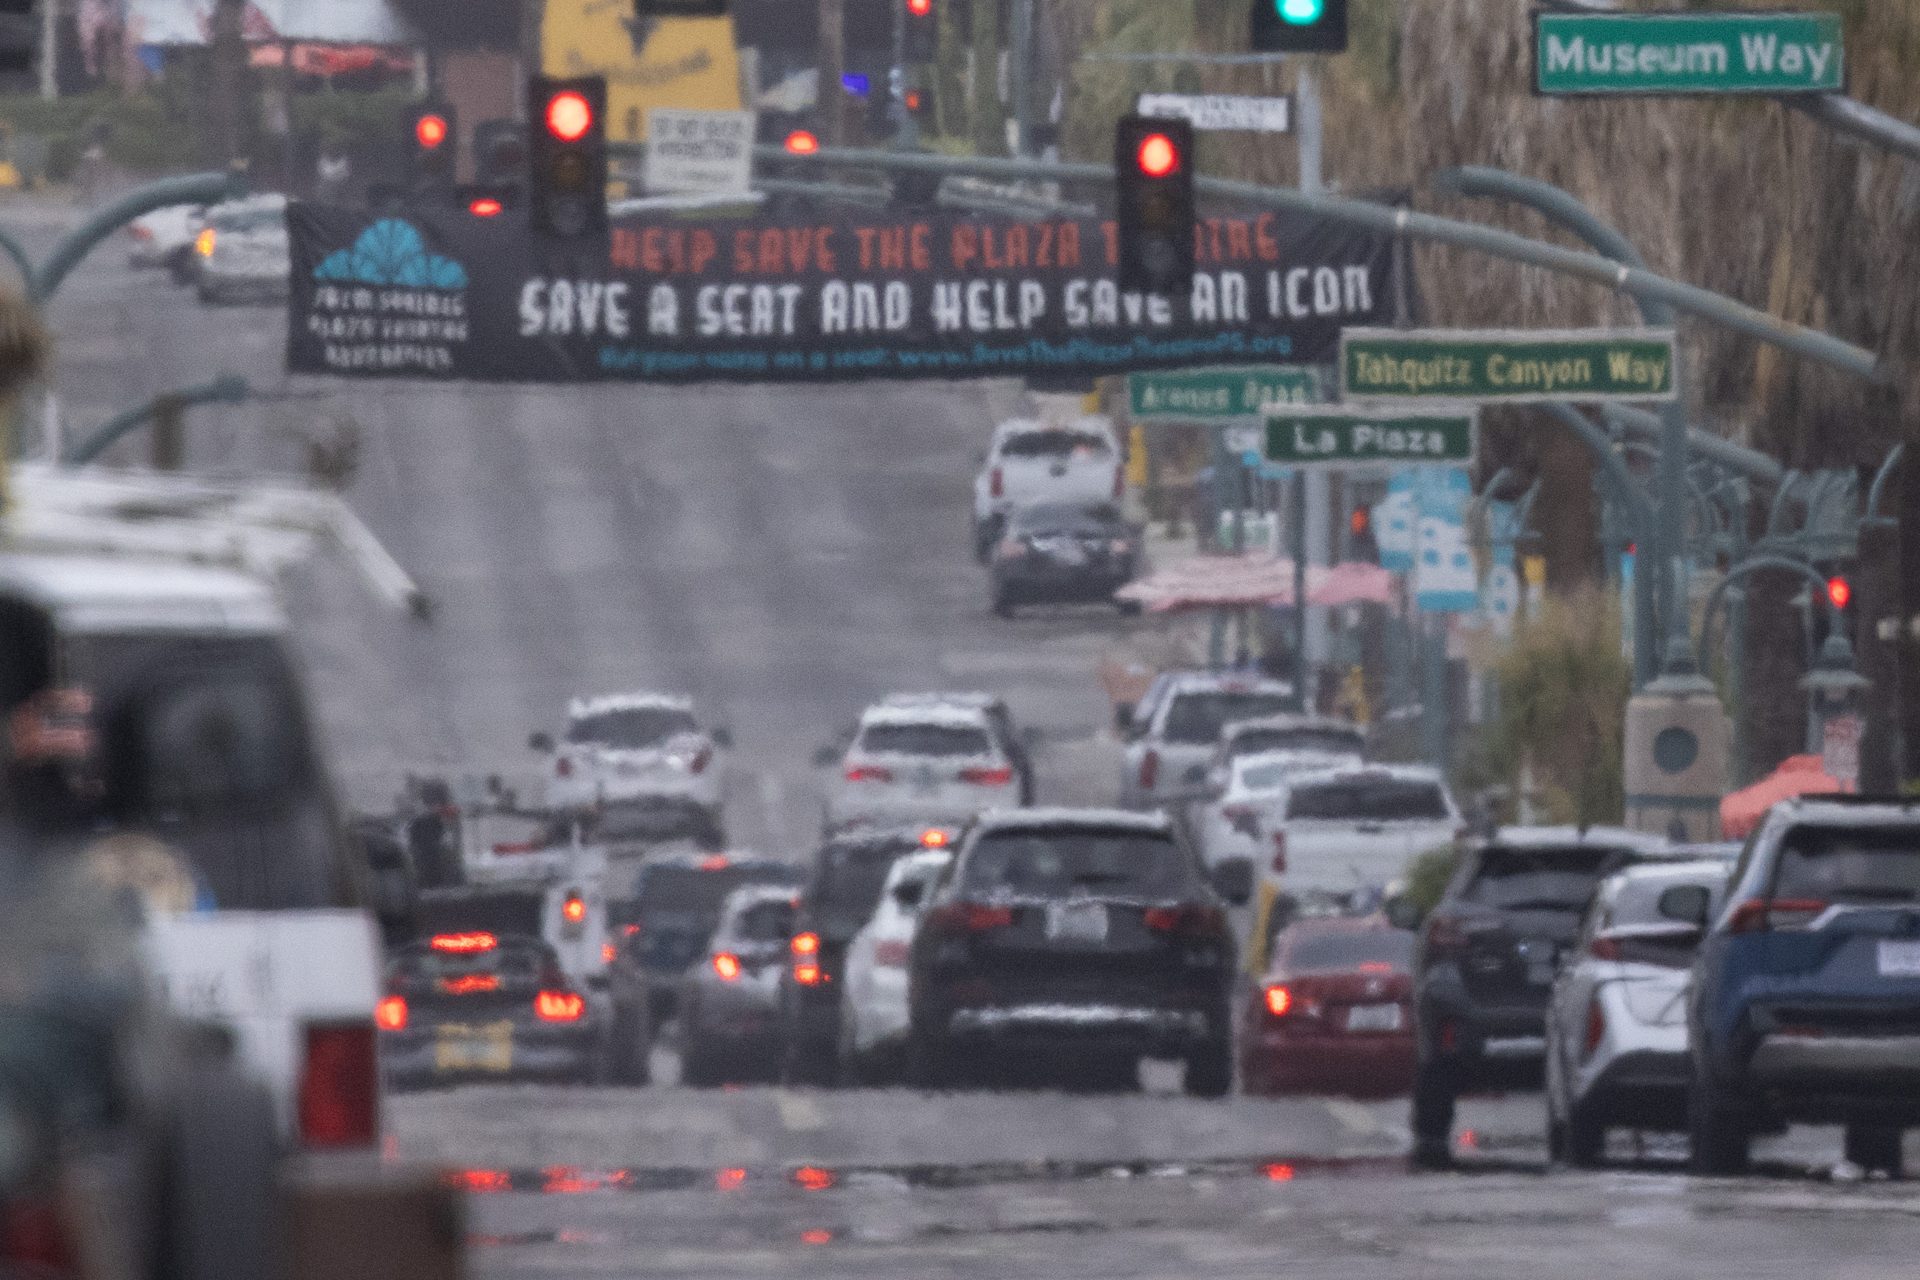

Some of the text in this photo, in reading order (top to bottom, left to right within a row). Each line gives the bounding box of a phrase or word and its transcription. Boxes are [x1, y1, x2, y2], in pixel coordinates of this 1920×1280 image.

[1547, 32, 1832, 82] Museum Way
[610, 227, 717, 271] HELP
[733, 226, 836, 272] SAVE
[854, 223, 930, 271] THE
[952, 218, 1081, 270] PLAZA
[518, 264, 1372, 337] SAVE A SEAT AND HELP SAVE AN ICON
[1355, 350, 1666, 393] Tahquitz Canyon Way
[1294, 424, 1337, 453] La
[1350, 424, 1445, 453] Plaza
